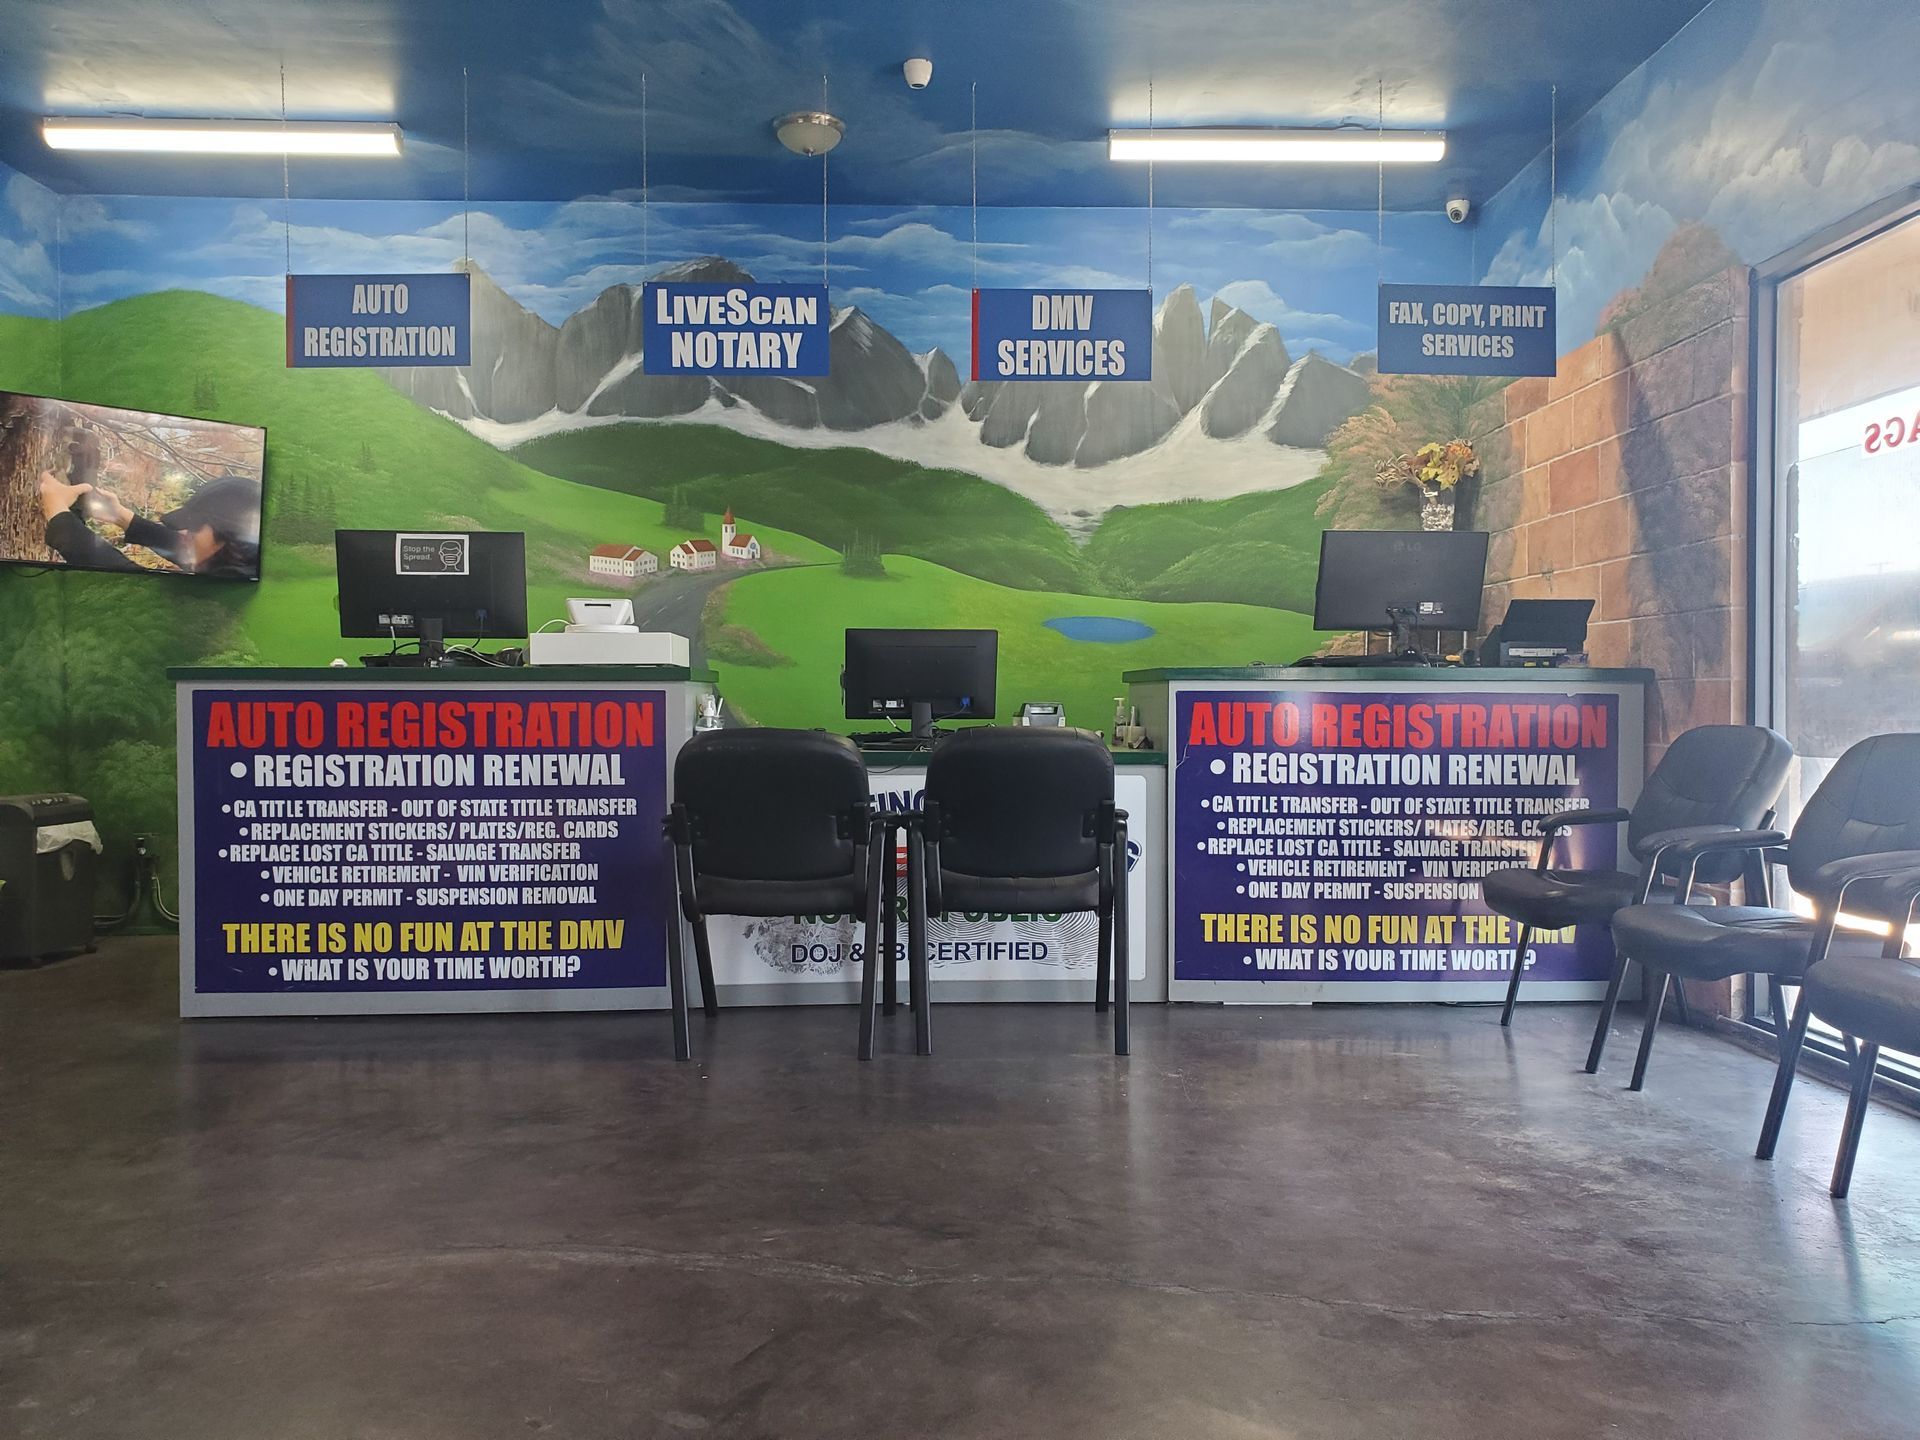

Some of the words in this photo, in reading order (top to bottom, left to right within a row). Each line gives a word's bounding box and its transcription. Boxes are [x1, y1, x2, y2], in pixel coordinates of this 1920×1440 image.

[352, 284, 408, 314] AUTO
[1033, 295, 1093, 330] DMV
[1390, 302, 1428, 326] FAX,
[1433, 303, 1485, 328] COPY,
[1490, 305, 1546, 327] PRINT
[305, 326, 455, 356] REGISTRATION
[672, 332, 802, 368] NOTARY
[1422, 334, 1513, 357] SERVICES
[998, 340, 1125, 375] SERVICES
[403, 545, 421, 553] Stop
[208, 702, 323, 747] AUTO
[338, 702, 653, 747] REGISTRATION
[1189, 702, 1299, 747] AUTO
[1311, 702, 1608, 749] REGISTRATION
[255, 754, 474, 787] REGISTRATION
[484, 754, 625, 786] RENEWAL
[1233, 752, 1440, 785] REGISTRATION
[1449, 755, 1580, 785] RENEWAL
[234, 800, 256, 817] CA
[259, 800, 303, 817] TITLE
[306, 800, 387, 817] TRANSFER
[402, 800, 433, 817] OUT
[438, 800, 457, 817] OF
[461, 800, 507, 816] STATE
[511, 799, 552, 816] TITLE
[556, 798, 636, 816] TRANSFER
[1213, 796, 1233, 812] CA
[1236, 796, 1277, 812] TITLE
[1281, 796, 1358, 814] TRANSFER
[1371, 797, 1401, 814] OUT
[1405, 798, 1423, 814] OF
[1426, 798, 1470, 814] STATE
[1473, 798, 1511, 814] TITLE
[1516, 798, 1590, 815] TRANSFER
[252, 823, 365, 840] REPLACEMENT
[369, 822, 456, 840] STICKERS/
[460, 822, 560, 839] PLATES/REG.
[564, 821, 618, 838] CARDS
[1229, 818, 1336, 835] REPLACEMENT
[1339, 819, 1421, 836] STICKERS/
[1425, 820, 1518, 836] PLATES/REG.
[1521, 820, 1572, 837] CADS
[231, 844, 299, 862] REPLACE
[304, 844, 342, 861] LOST
[346, 844, 368, 861] CA
[371, 844, 413, 861] TITLE
[427, 843, 496, 861] SALVAGE
[499, 843, 580, 860] TRANSFER
[1208, 838, 1273, 855] REPLACE
[1277, 839, 1314, 856] LOST
[1318, 839, 1338, 856] CA
[1342, 840, 1381, 856] TITLE
[1393, 840, 1459, 856] SALVAGE
[1463, 841, 1536, 857] TRANSFER
[273, 866, 338, 883] VEHICLE
[342, 865, 440, 883] RETIREMENT
[457, 865, 485, 882] VIN
[489, 864, 598, 881] VERIFICATION
[1248, 859, 1309, 876] VEHICLE
[1314, 860, 1406, 877] RETIREMENT
[1422, 861, 1448, 877] VIN
[1451, 861, 1549, 877] VERIFI
[274, 889, 304, 906] ONE
[309, 889, 339, 906] DAY
[343, 889, 403, 906] PERMIT
[417, 888, 518, 905] SUSPENSION
[523, 887, 596, 904] REMOVAL
[1249, 881, 1278, 898] ONE
[1282, 882, 1310, 898] DAY
[1314, 882, 1371, 899] PERMIT
[1384, 883, 1479, 900] SUSPENSION
[223, 924, 310, 953] THERE
[318, 923, 346, 952] IS
[354, 923, 392, 952] NO
[400, 922, 456, 952] FUN
[460, 922, 494, 951] AT
[500, 921, 552, 950] THE
[560, 920, 624, 949] DMV
[1201, 914, 1283, 942] THERE
[1291, 915, 1317, 943] IS
[1325, 915, 1360, 943] NO
[1369, 916, 1417, 944] FUN
[1424, 916, 1456, 943] AT
[1462, 916, 1510, 943] THE
[792, 944, 841, 963] DOJ
[850, 943, 865, 962] &
[1256, 949, 1314, 970] WHAT
[1319, 949, 1338, 970] IS
[1342, 949, 1395, 970] YOUR
[1400, 950, 1446, 970] TIME
[282, 959, 343, 980] WHAT
[348, 958, 368, 980] IS
[374, 958, 429, 980] YOUR
[434, 958, 484, 979] TIME
[489, 956, 580, 978] WORTH?
